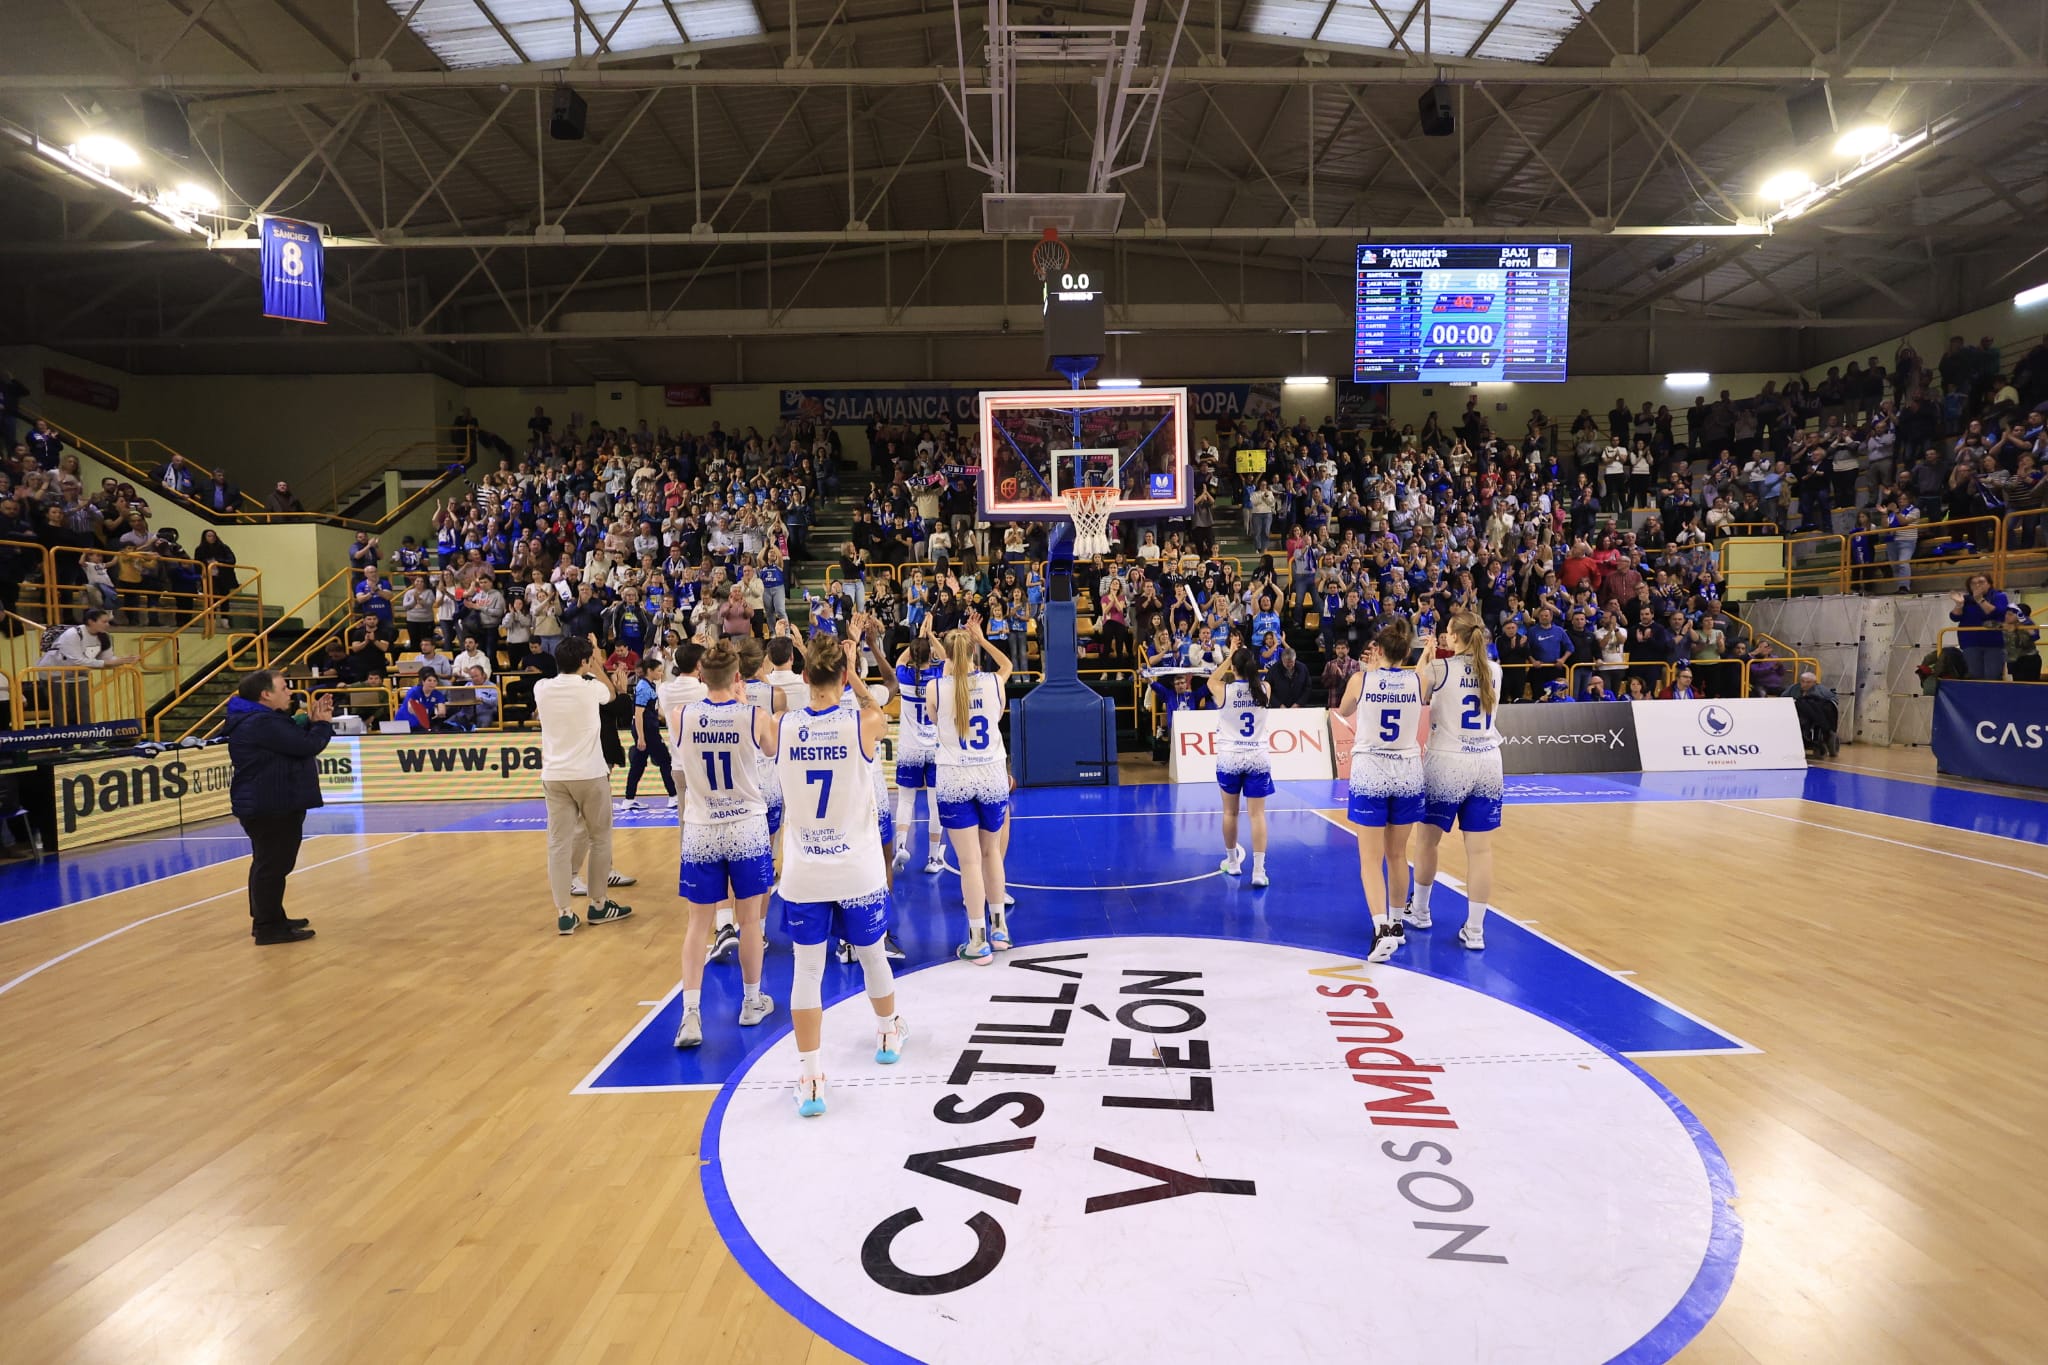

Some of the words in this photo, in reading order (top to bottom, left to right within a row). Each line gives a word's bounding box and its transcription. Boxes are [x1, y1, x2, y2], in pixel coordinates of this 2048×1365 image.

[282, 241, 304, 276] 8
[1389, 258, 1441, 268] AVENIDA
[1498, 258, 1531, 268] Ferrol
[1501, 247, 1529, 258] BAXI
[1061, 273, 1090, 289] 0.0
[1429, 273, 1453, 290] 87
[1432, 324, 1493, 345] 00:00
[1434, 352, 1445, 366] 4
[823, 396, 950, 421] SALAMANCA
[1240, 712, 1255, 737] 3
[1379, 709, 1401, 742] 5
[693, 731, 740, 744] HOWARD
[1537, 733, 1607, 745] FACTOR
[1682, 745, 1701, 756] EL
[1704, 744, 1760, 756] GANSO
[789, 745, 848, 761] MESTRES
[701, 751, 734, 791] 11
[62, 761, 189, 834] pans
[193, 769, 203, 795] &
[805, 769, 834, 819] 7
[1080, 969, 1214, 1111] LEÓN
[1308, 964, 1459, 1129] IMPULSA
[860, 953, 1088, 1296] CASTILLA
[1085, 1147, 1256, 1214] Y
[1381, 1140, 1509, 1264] NOS
